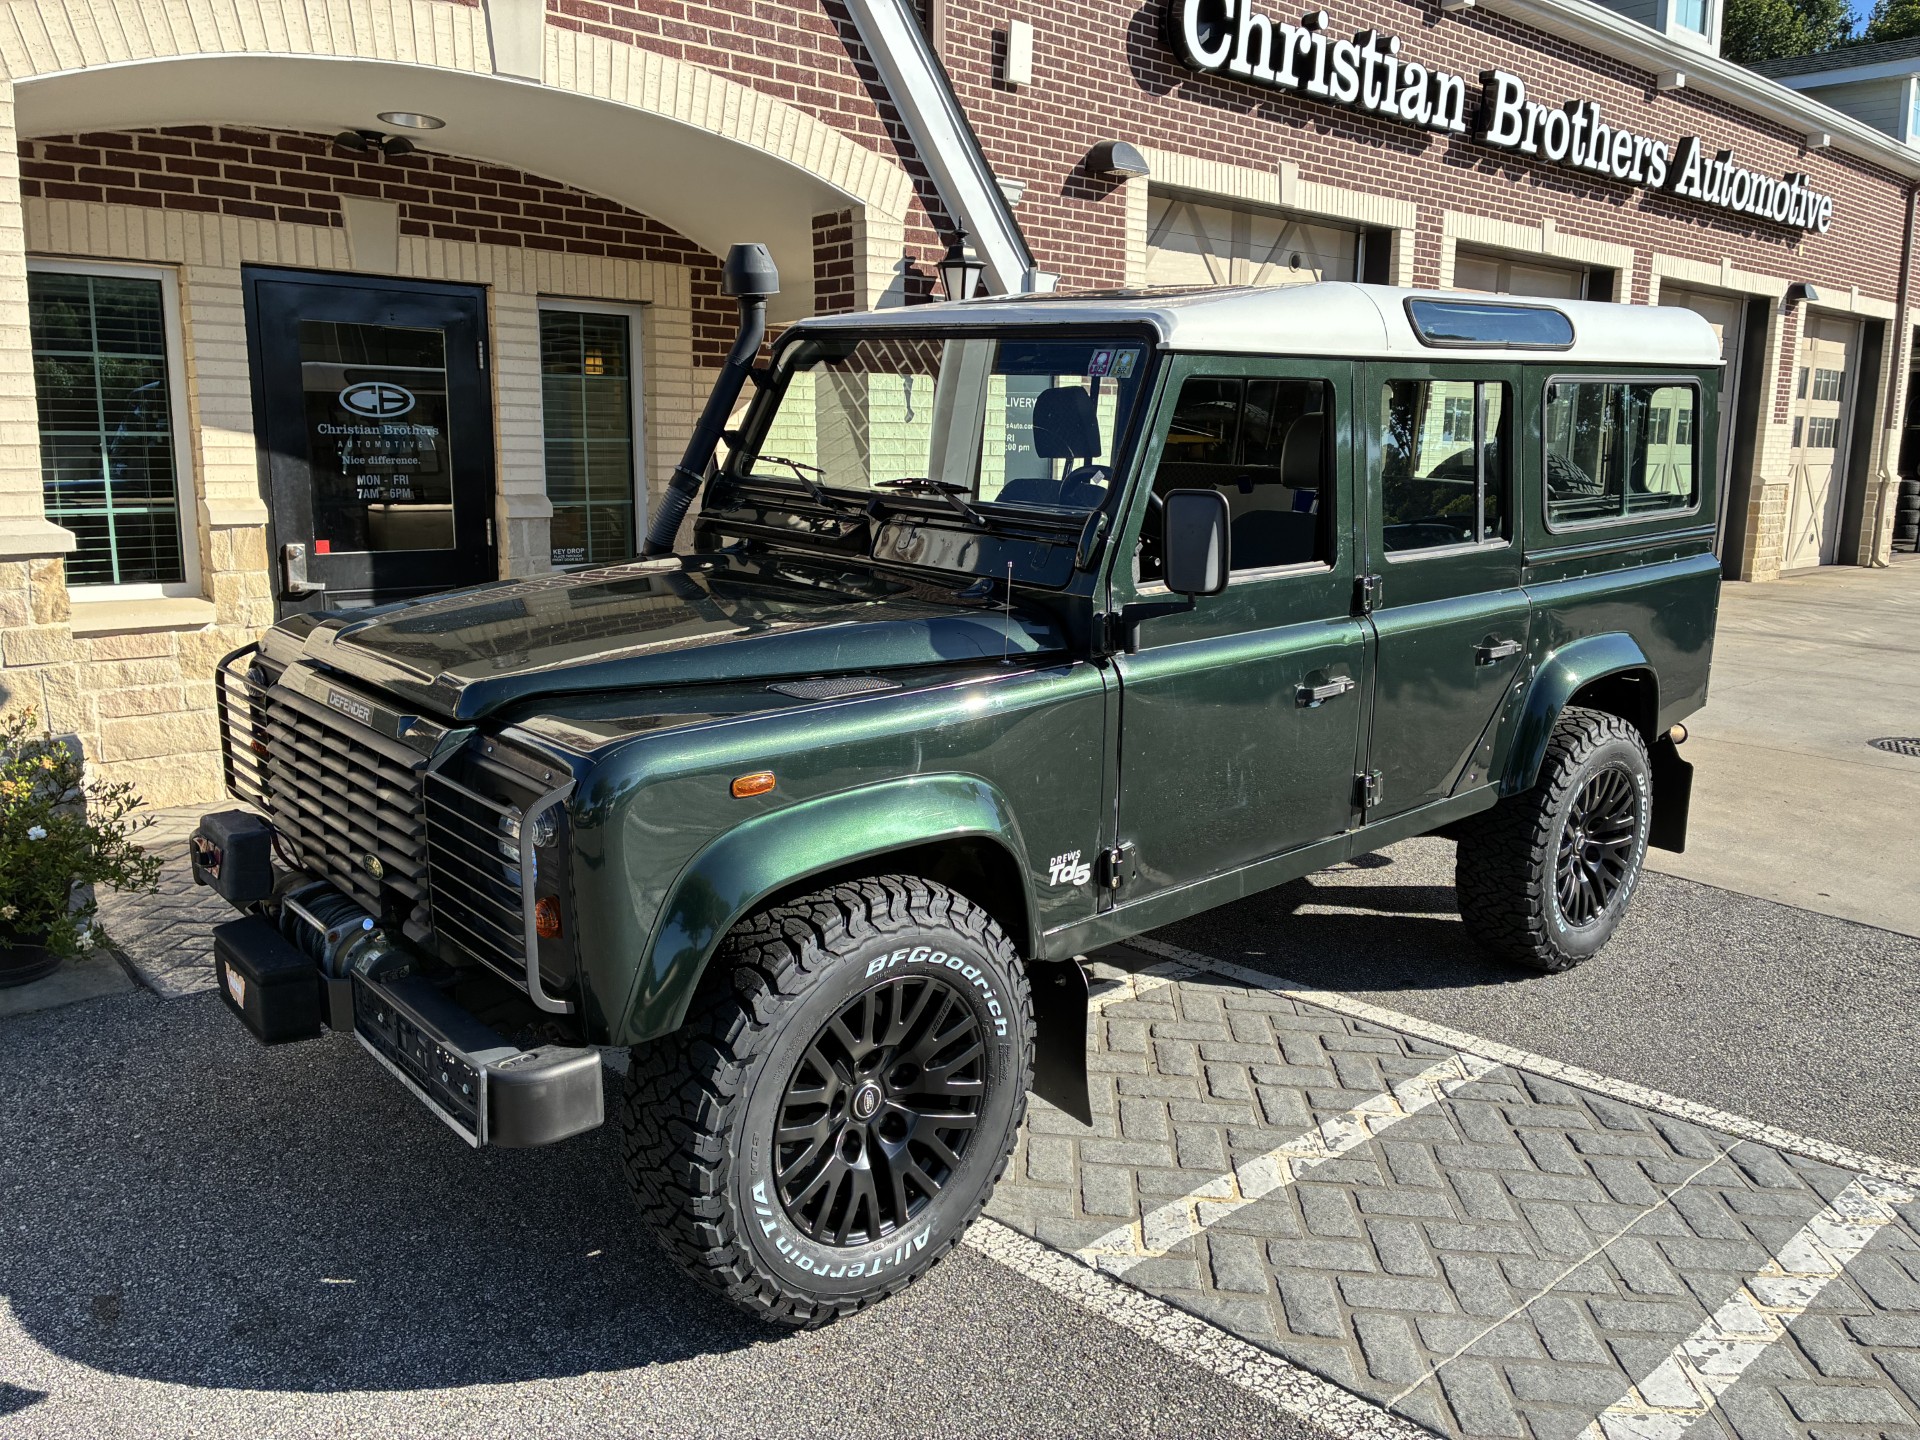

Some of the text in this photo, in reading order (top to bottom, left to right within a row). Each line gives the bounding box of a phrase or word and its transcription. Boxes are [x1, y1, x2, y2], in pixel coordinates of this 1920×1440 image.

[1184, 0, 1833, 233] Christian Brothers Automotive
[317, 423, 440, 436] Christian Brothers
[337, 440, 423, 448] AUTOMOTIVE
[1018, 444, 1030, 453] pm
[341, 455, 422, 465] Nice difference.
[356, 475, 381, 486] MON
[393, 475, 409, 485] FRI
[356, 488, 380, 499] 7AM
[389, 488, 411, 499] 6PM
[566, 547, 585, 555] DROP
[329, 691, 370, 721] DEFENDER
[1050, 849, 1081, 867] DREWS
[1048, 859, 1091, 887] Td5
[864, 945, 1008, 1037] BFGoodrich
[751, 1179, 777, 1239] T/A
[774, 1223, 931, 1279] All-Terrain
